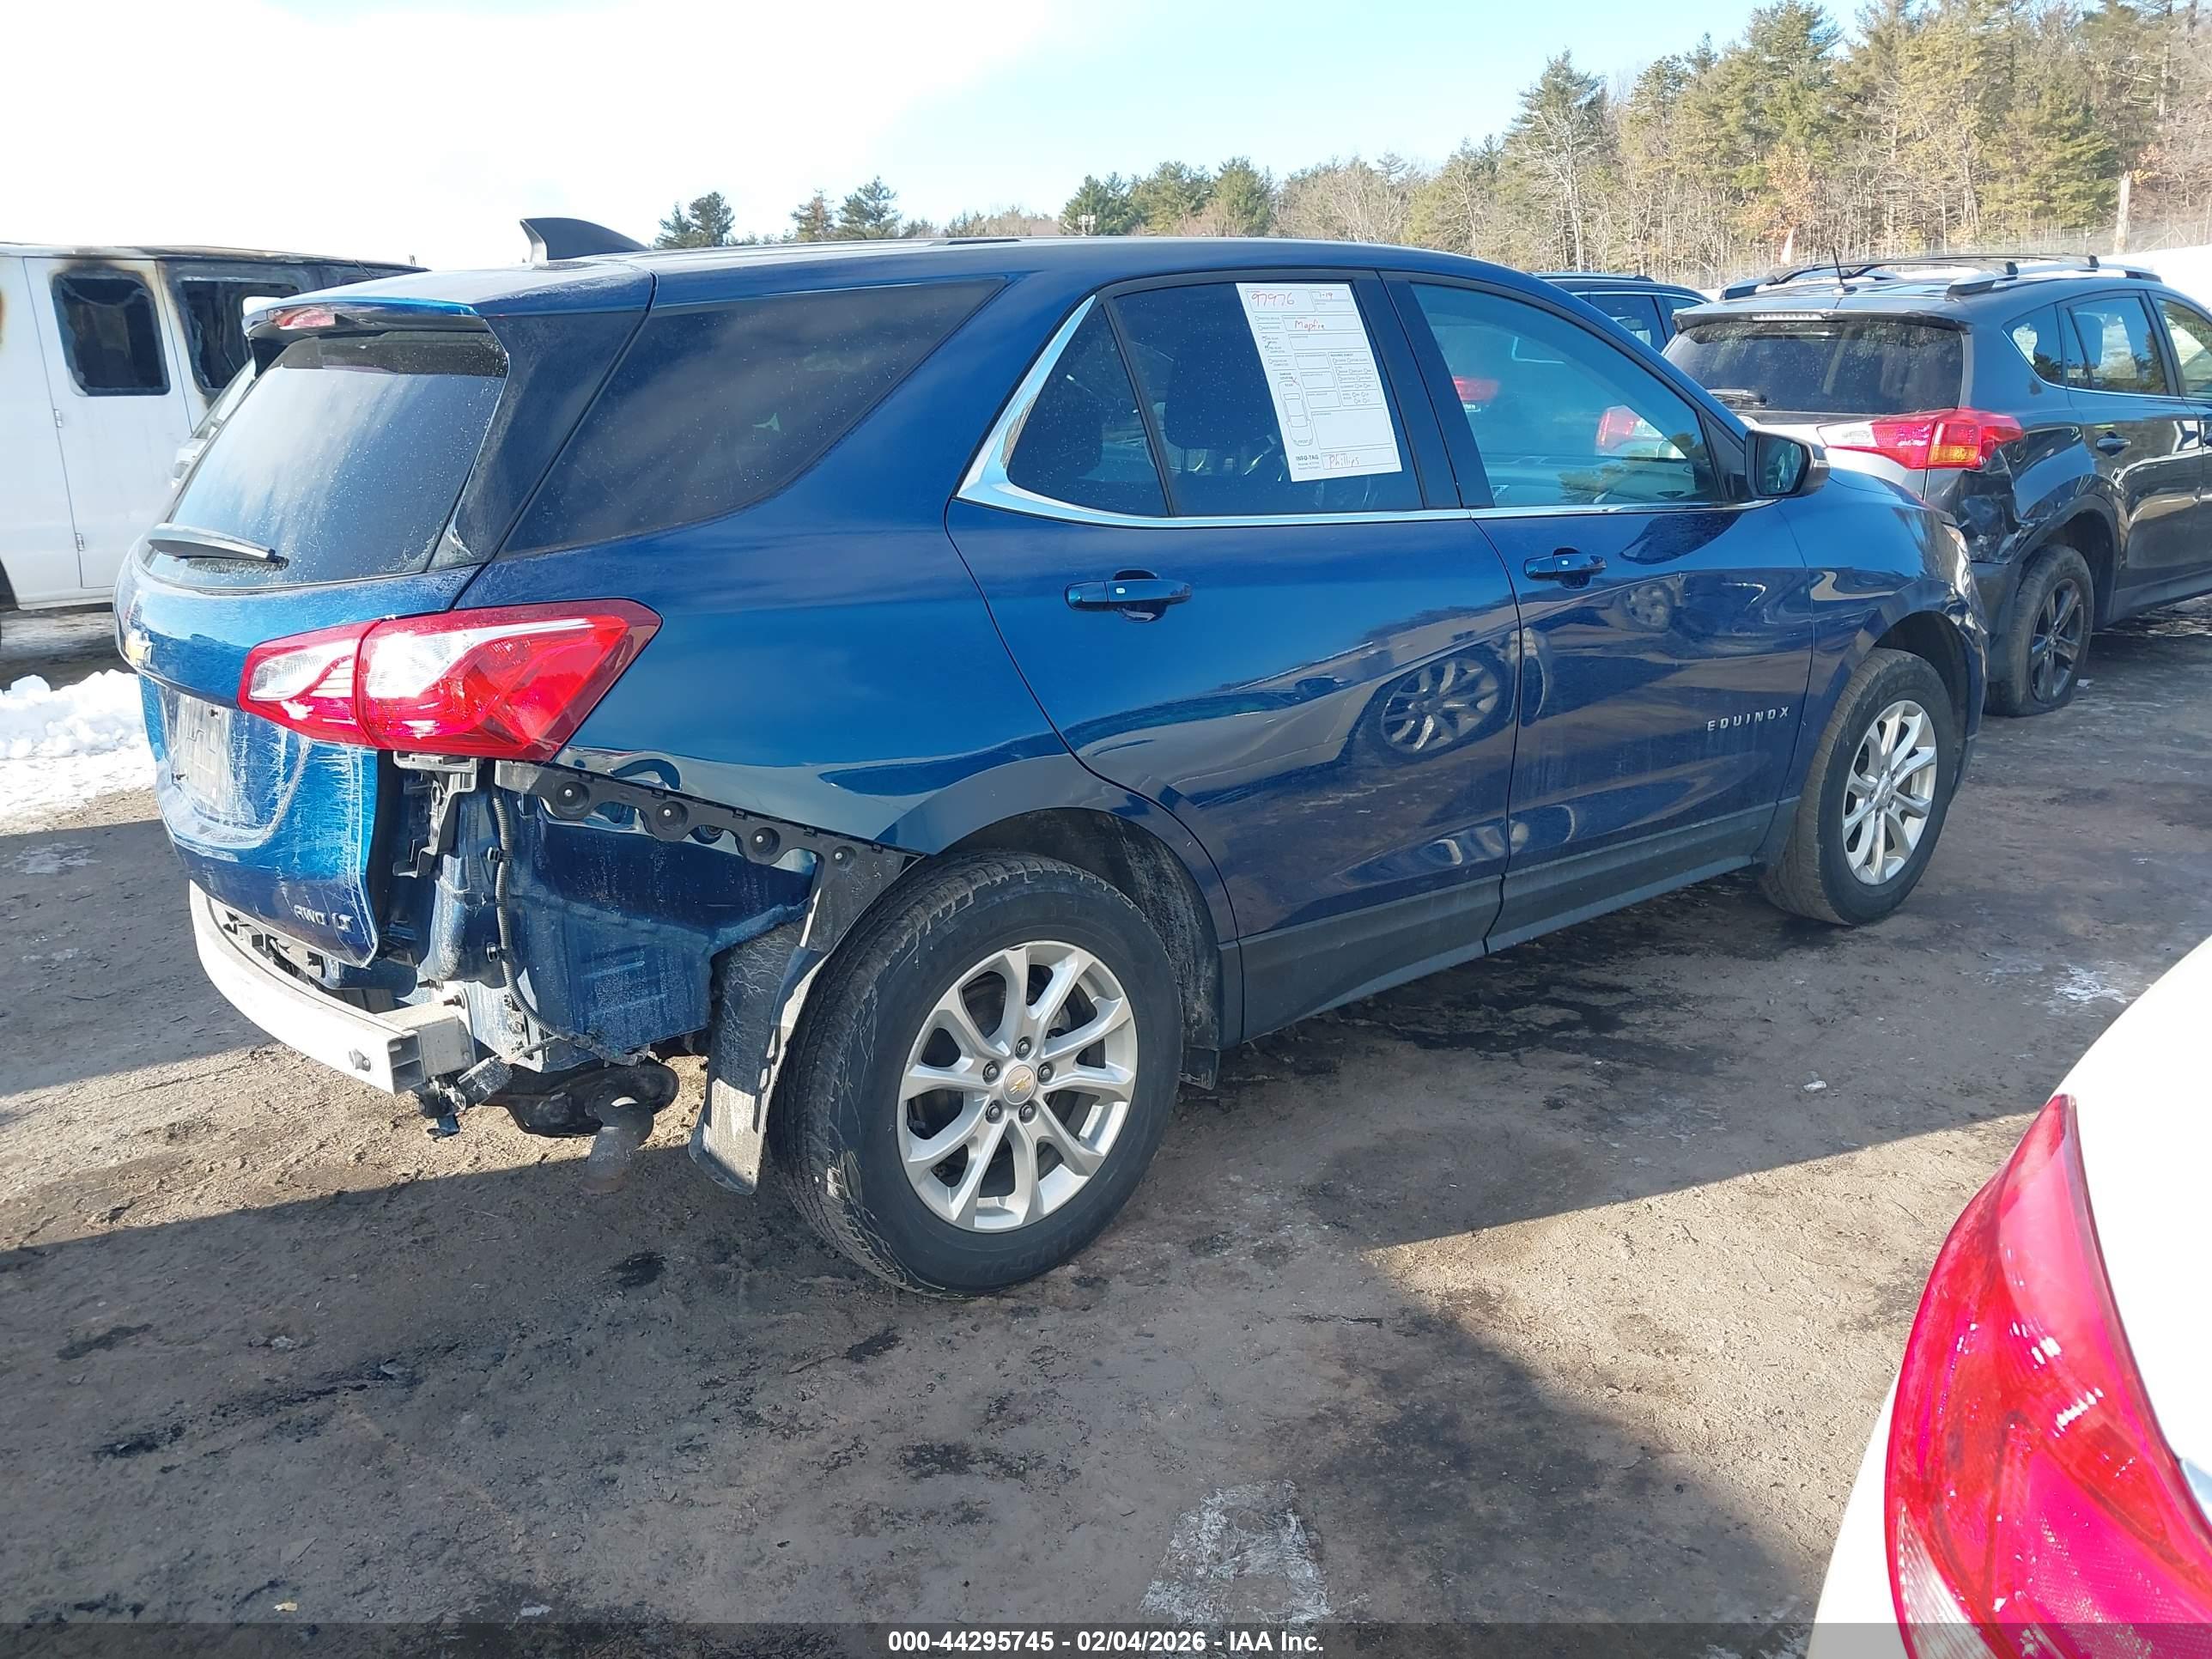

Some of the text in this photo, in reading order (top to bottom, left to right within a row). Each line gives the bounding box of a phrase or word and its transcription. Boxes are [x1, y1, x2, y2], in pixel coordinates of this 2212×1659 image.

[1251, 292, 1295, 307] 97976
[1706, 706, 1790, 732] EQUINOX
[293, 904, 327, 927] AWD
